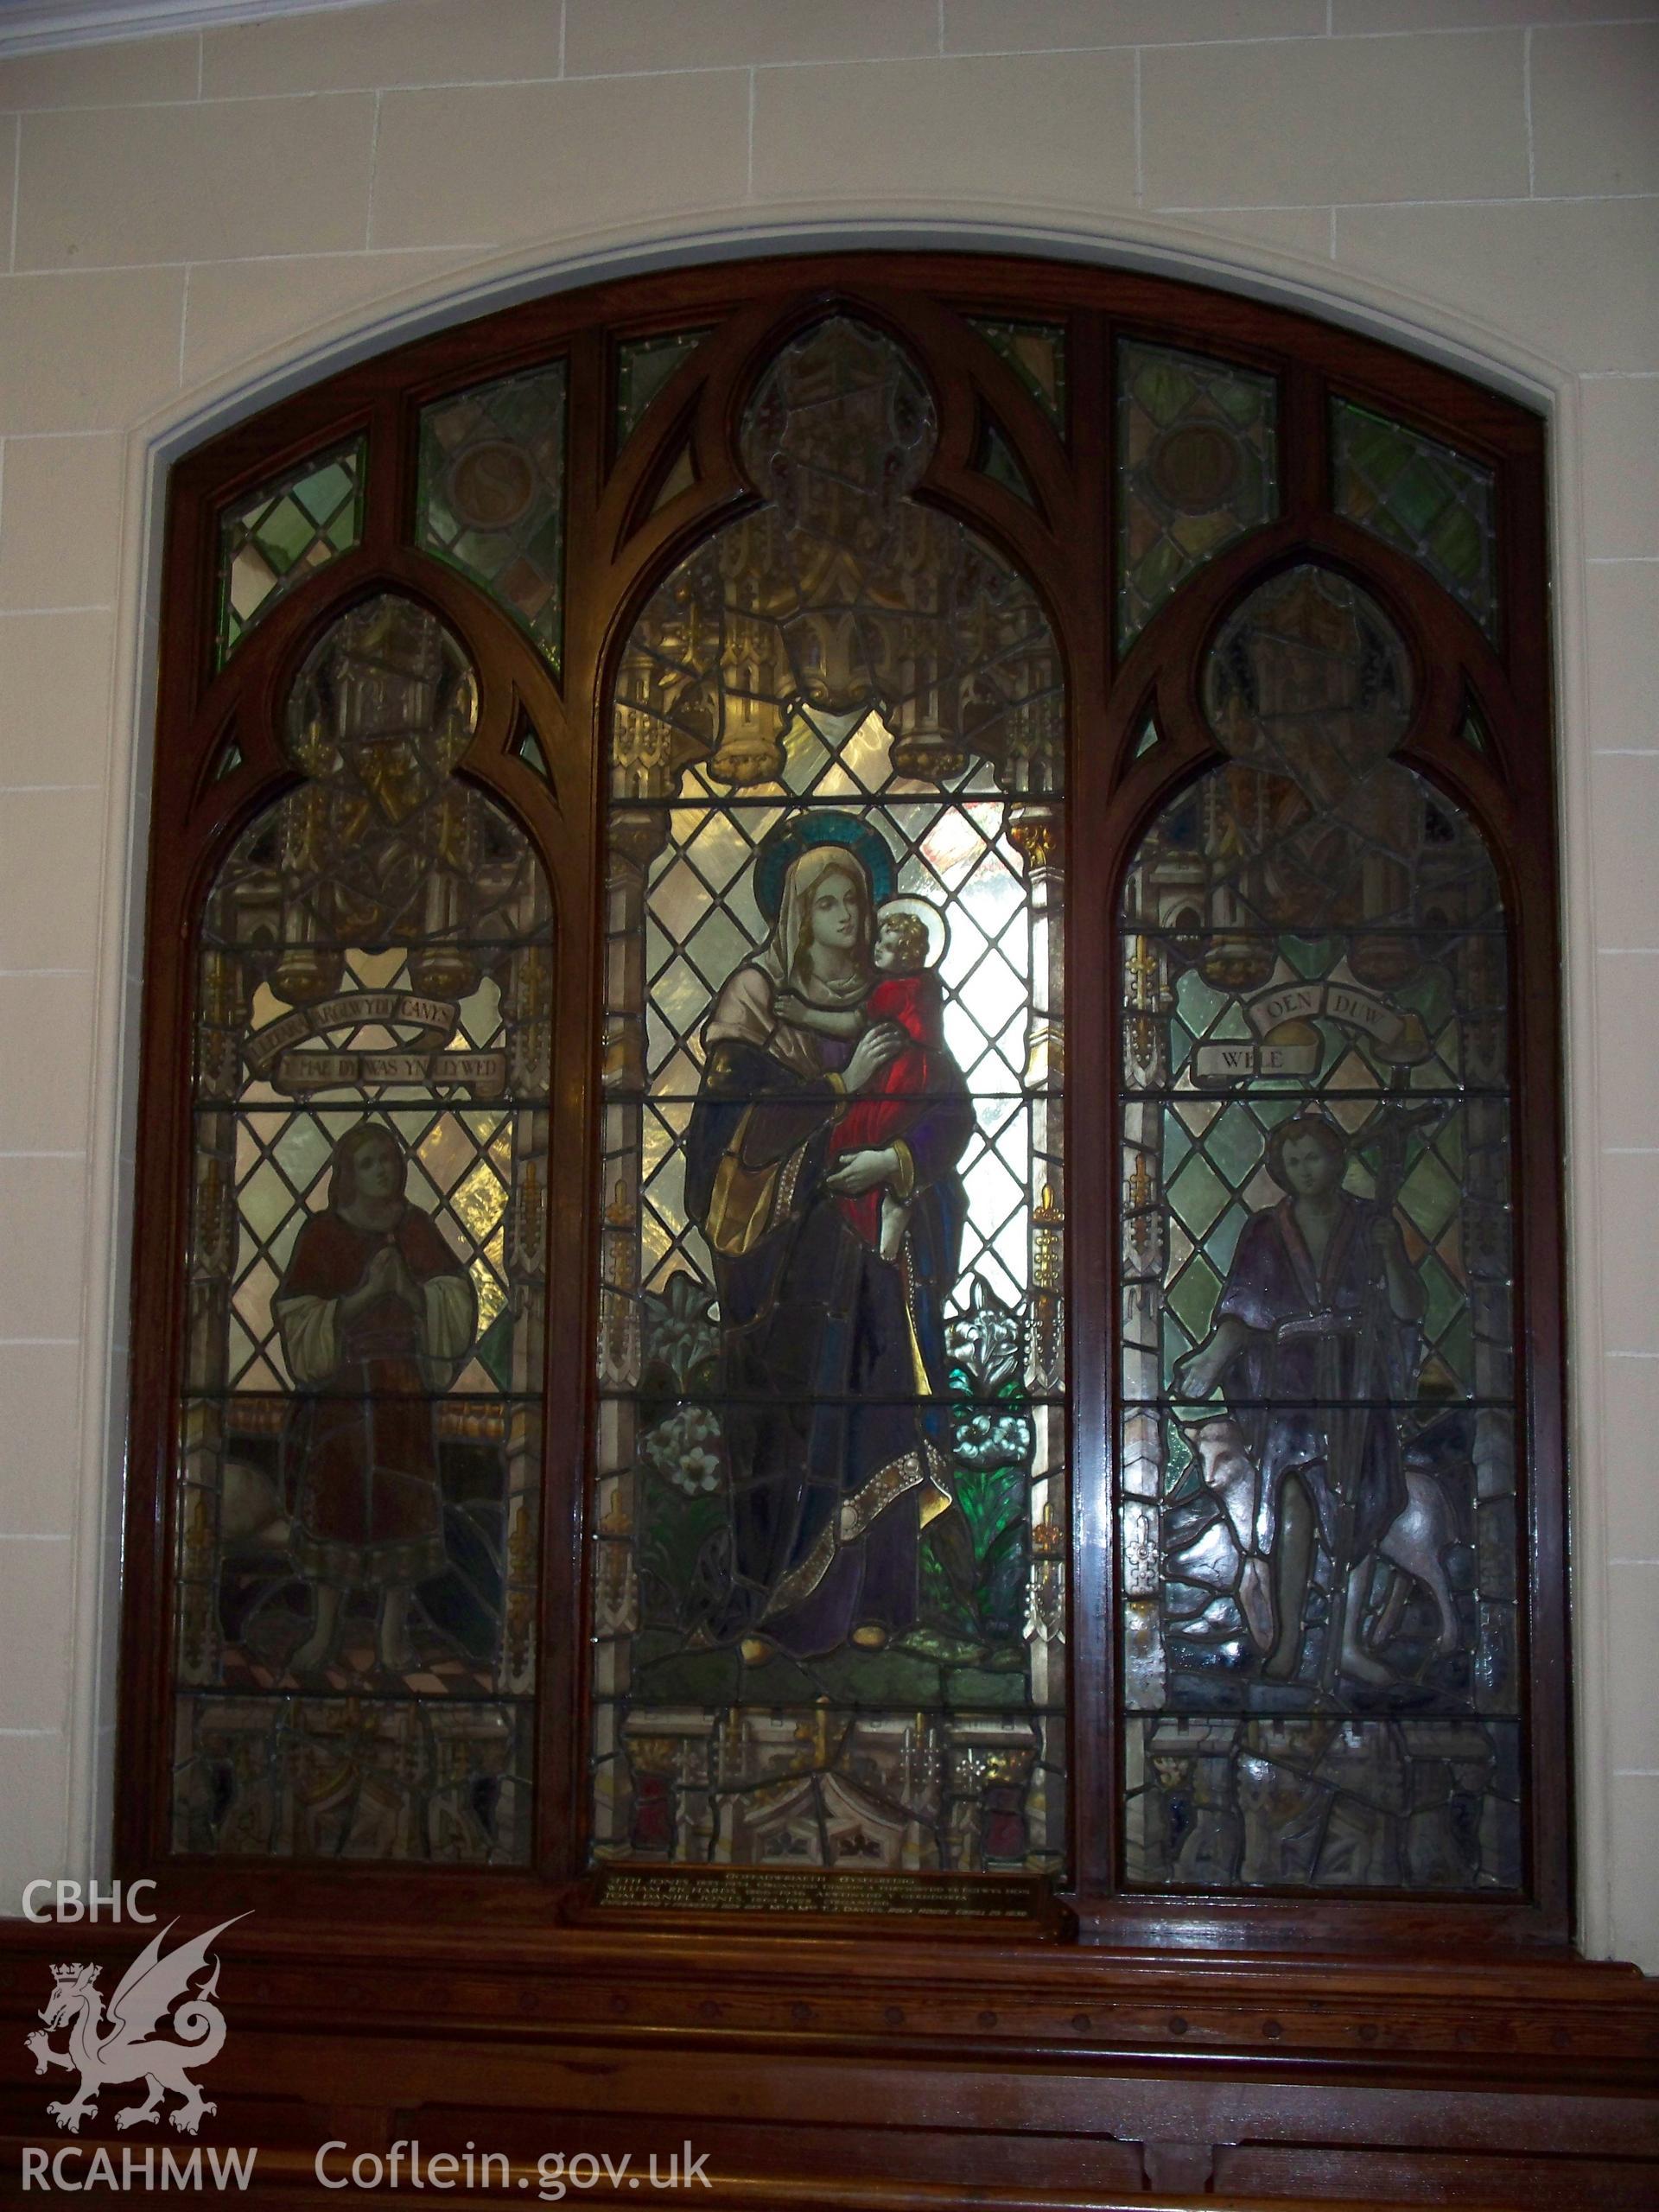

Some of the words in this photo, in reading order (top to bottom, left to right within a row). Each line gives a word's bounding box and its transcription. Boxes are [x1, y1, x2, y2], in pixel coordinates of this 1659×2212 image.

[1267, 992, 1312, 1019] OEN
[1334, 995, 1383, 1024] DUW
[365, 1059, 397, 1075] WAS
